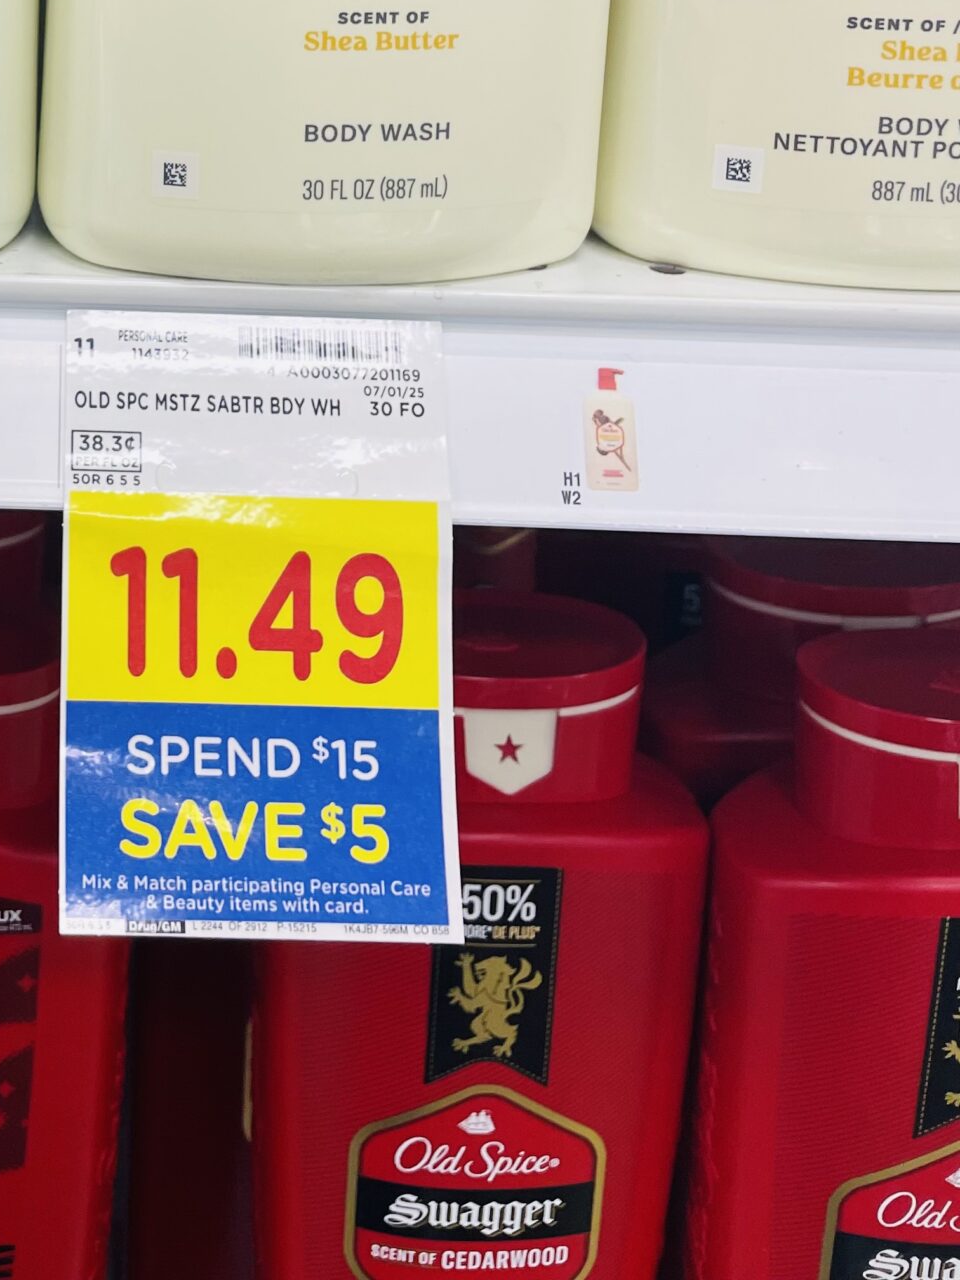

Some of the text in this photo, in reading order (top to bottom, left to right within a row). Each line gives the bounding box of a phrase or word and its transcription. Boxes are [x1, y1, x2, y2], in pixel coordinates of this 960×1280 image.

[337, 12, 400, 25] SCENT
[846, 16, 913, 31] SCENT
[304, 30, 460, 52] Shea Butter
[881, 39, 948, 62] Shea
[846, 66, 944, 90] Beurre
[304, 122, 451, 142] BODY WASH
[878, 116, 949, 137] BODY
[773, 132, 925, 159] NETTOYANT
[871, 180, 905, 202] 887
[118, 330, 188, 343] PERSONAL CARE
[131, 347, 189, 361] 1143932
[363, 386, 424, 398] 07/01/25
[75, 391, 341, 416] OLD SPC MSTZ SABTR BDY WH
[79, 435, 135, 452] 38.3¢
[563, 472, 581, 487] H1
[561, 490, 581, 505] W2
[110, 546, 404, 684] 11.49
[126, 735, 380, 781] SPEND $15
[119, 798, 390, 864] SAVE $5
[82, 874, 431, 896] Mix Match participating Personal Care
[163, 896, 320, 914] Beauty items with
[462, 883, 536, 922] 50%
[128, 921, 181, 932] Drug/GM
[394, 1136, 465, 1176] Old
[384, 1193, 564, 1236] Swagger
[877, 1191, 952, 1229] Old
[370, 1244, 569, 1270] SCENT CEDARWOOD
